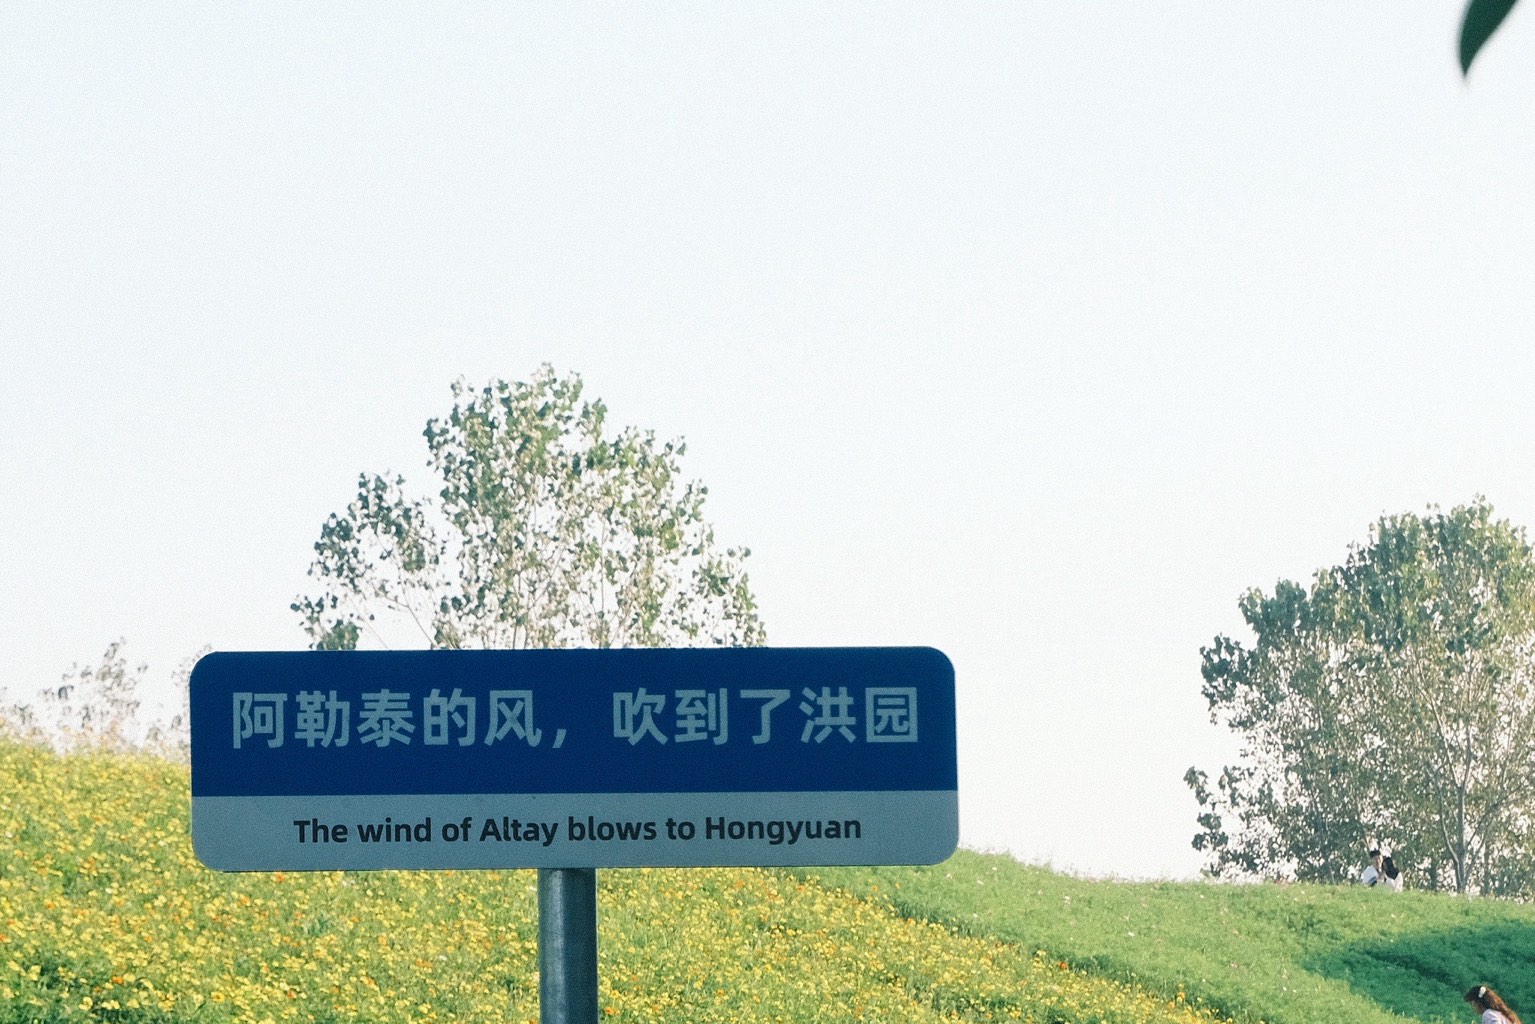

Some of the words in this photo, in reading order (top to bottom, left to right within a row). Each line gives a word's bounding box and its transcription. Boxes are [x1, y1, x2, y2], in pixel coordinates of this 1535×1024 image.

[232, 686, 918, 749] 阿勒泰的风，吹到了洪园
[293, 819, 349, 843] The
[357, 817, 432, 843] wind
[441, 817, 472, 842] of
[479, 817, 559, 847] Altay
[568, 816, 657, 841] blows
[666, 817, 696, 841] to
[705, 816, 862, 846] Hongyuan
